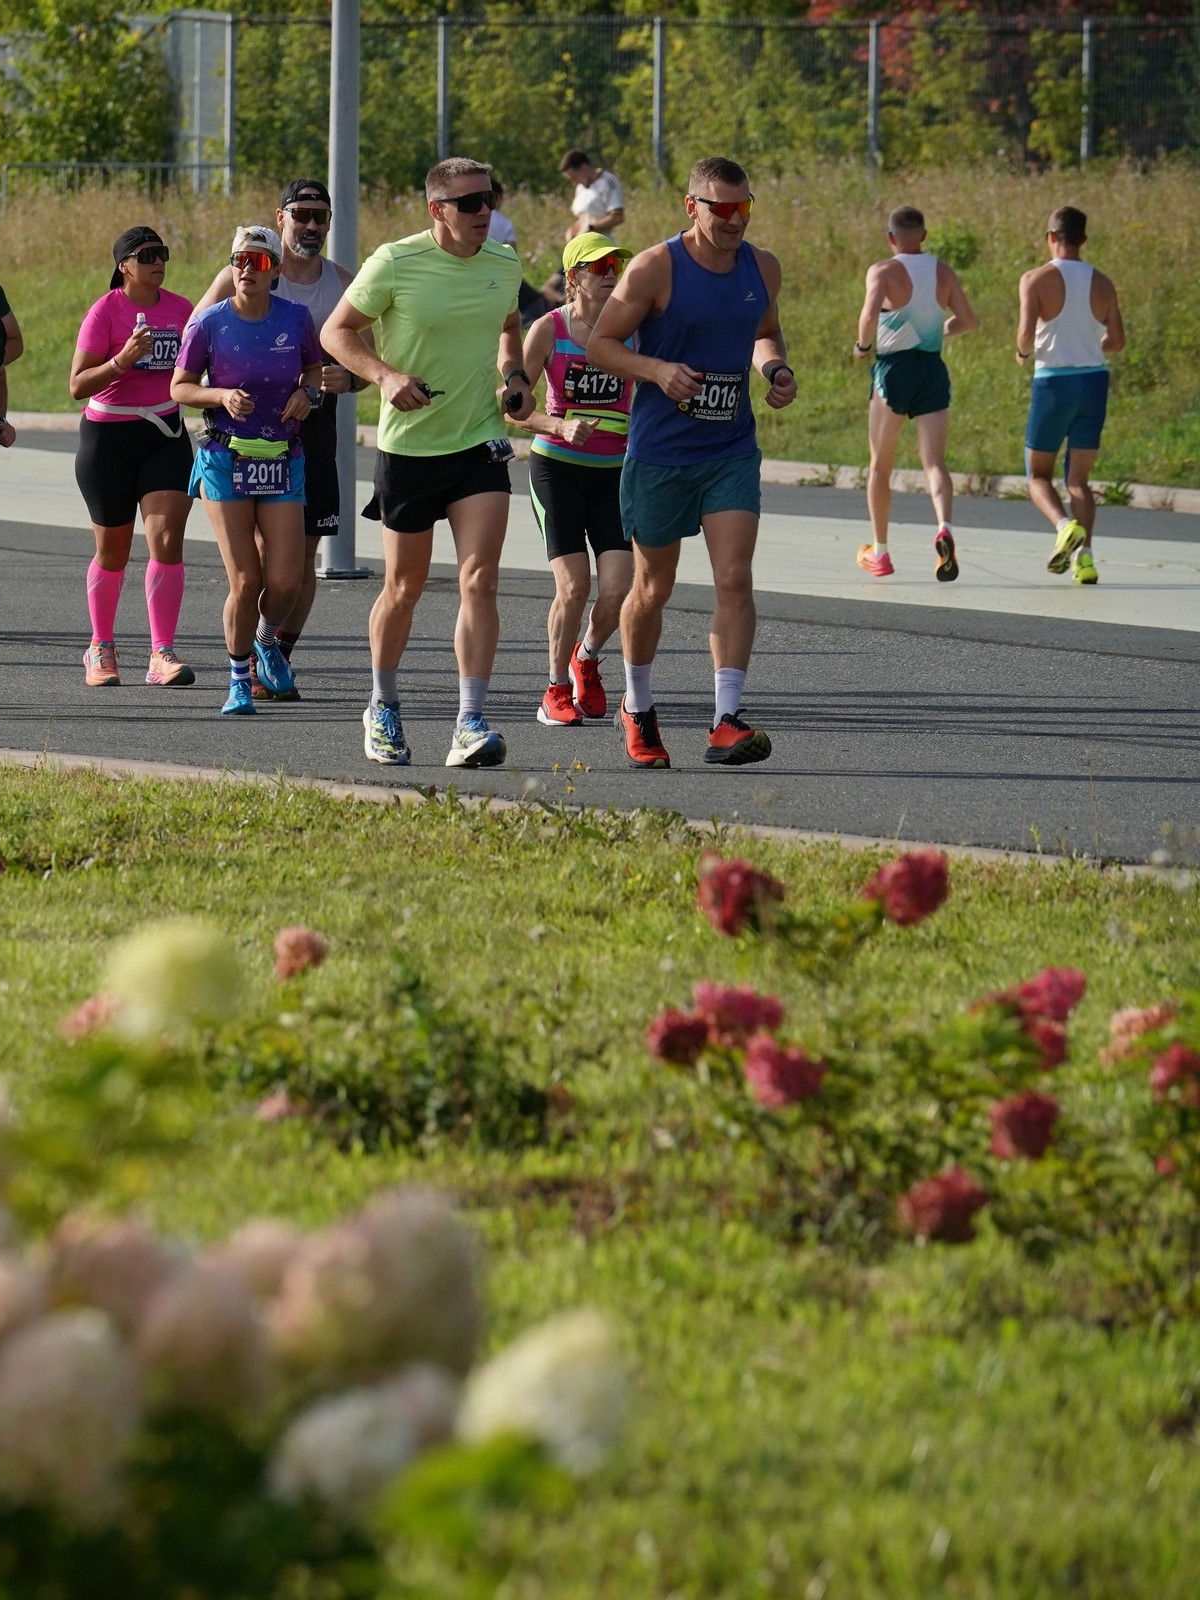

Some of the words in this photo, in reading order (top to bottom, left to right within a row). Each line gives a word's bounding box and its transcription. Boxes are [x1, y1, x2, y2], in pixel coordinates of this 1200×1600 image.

[150, 340, 178, 360] 073
[577, 373, 619, 394] 4173
[705, 375, 742, 383] МАРАФОН
[693, 383, 737, 409] 4016
[692, 408, 733, 416] АЛЕКСАНДР
[247, 463, 282, 484] 2011
